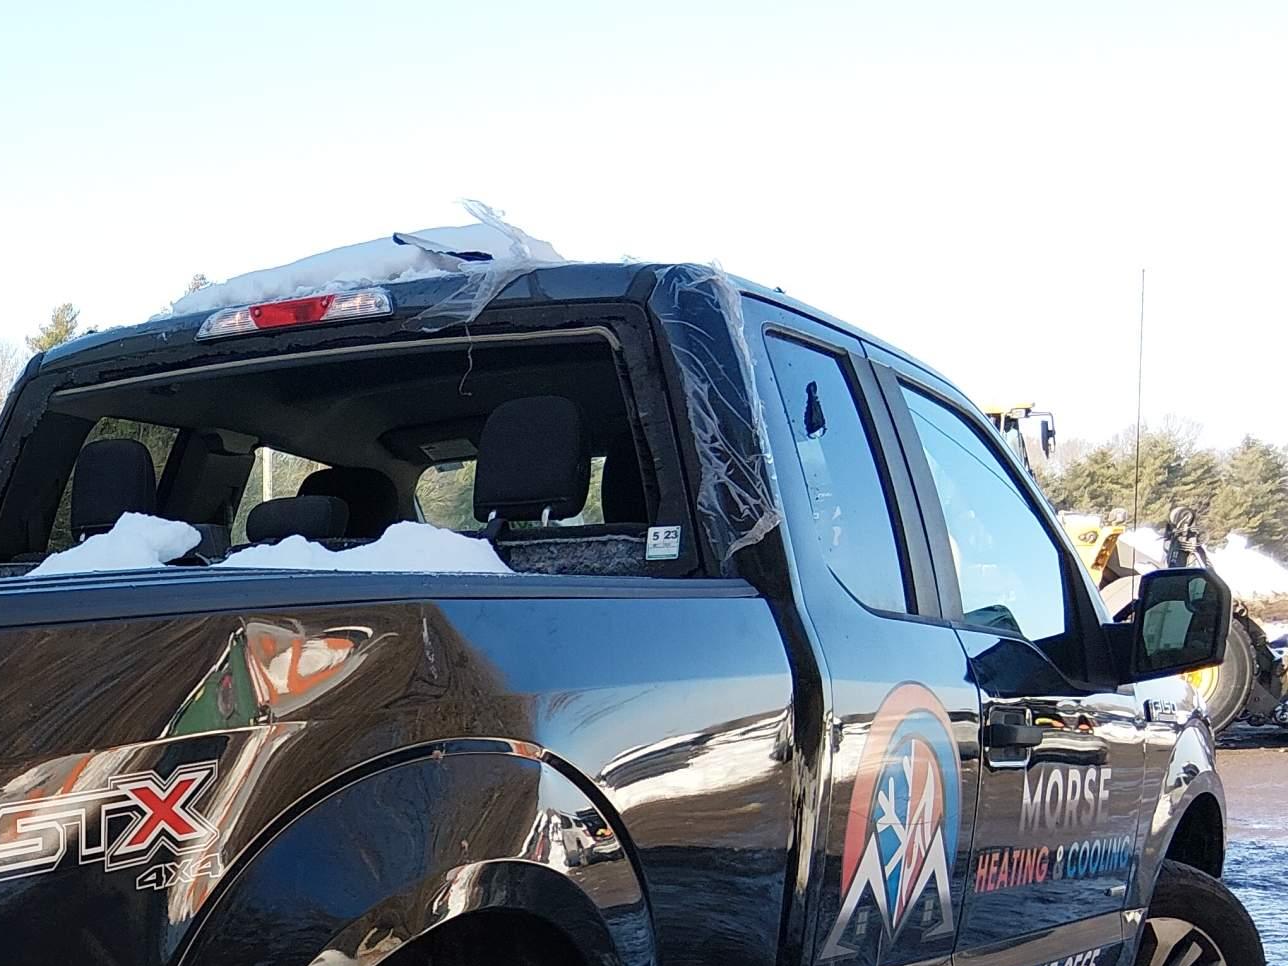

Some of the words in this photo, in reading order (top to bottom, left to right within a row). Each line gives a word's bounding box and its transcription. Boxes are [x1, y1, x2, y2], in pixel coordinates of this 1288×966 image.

[652, 531, 660, 541] 5
[663, 530, 678, 540] 23
[1020, 766, 1112, 836] MORSE
[975, 847, 1049, 893] HEATING
[1053, 849, 1063, 880] &
[1066, 834, 1131, 879] COOLING
